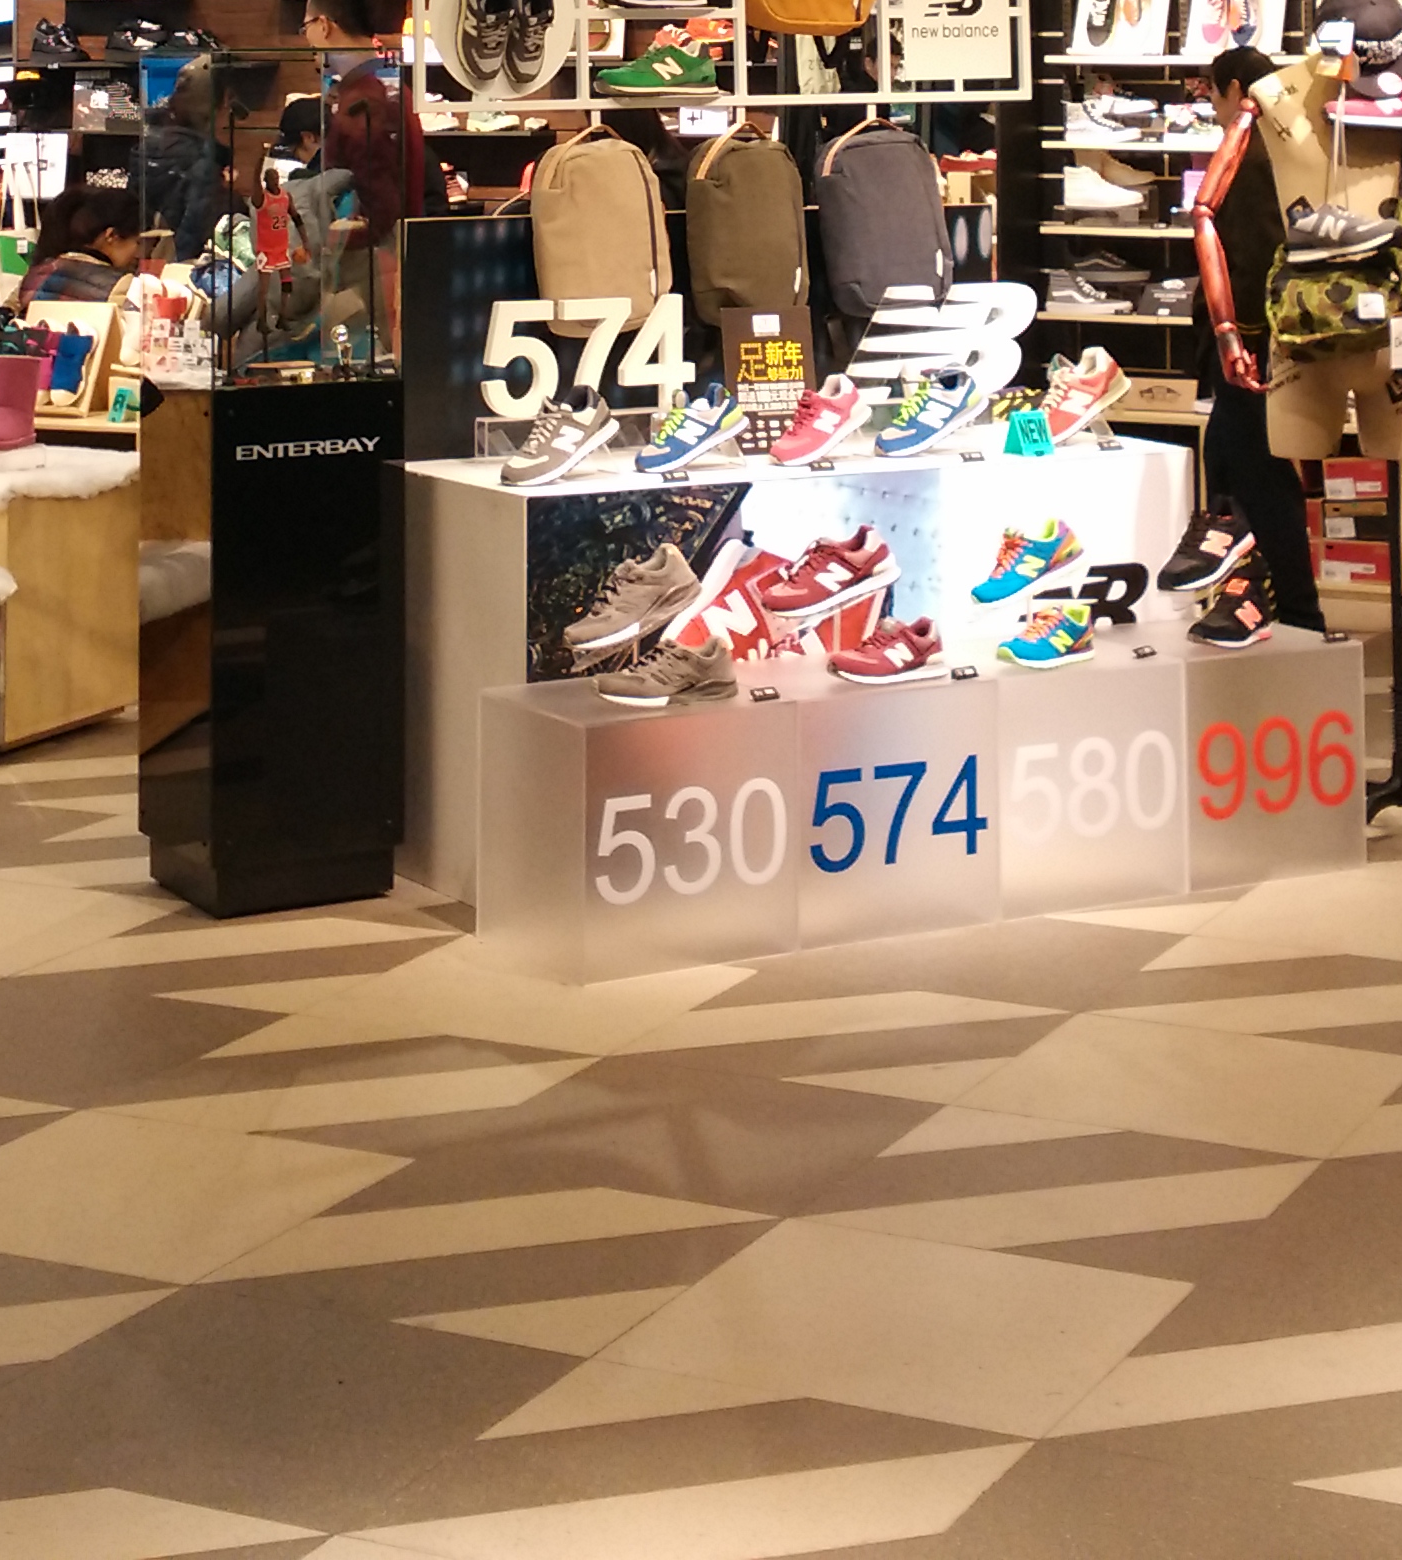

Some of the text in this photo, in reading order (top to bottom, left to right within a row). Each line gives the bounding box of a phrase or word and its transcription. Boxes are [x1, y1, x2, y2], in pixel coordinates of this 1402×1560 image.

[911, 24, 999, 38] new balance
[272, 216, 287, 230] 23
[480, 294, 696, 418] 574
[765, 340, 804, 366] 新年
[236, 436, 380, 461] ENTERBAY
[1021, 412, 1049, 444] NEW
[1009, 729, 1178, 841] 580
[1196, 709, 1357, 821] 996
[595, 777, 788, 905] 530
[809, 754, 989, 873] 574
